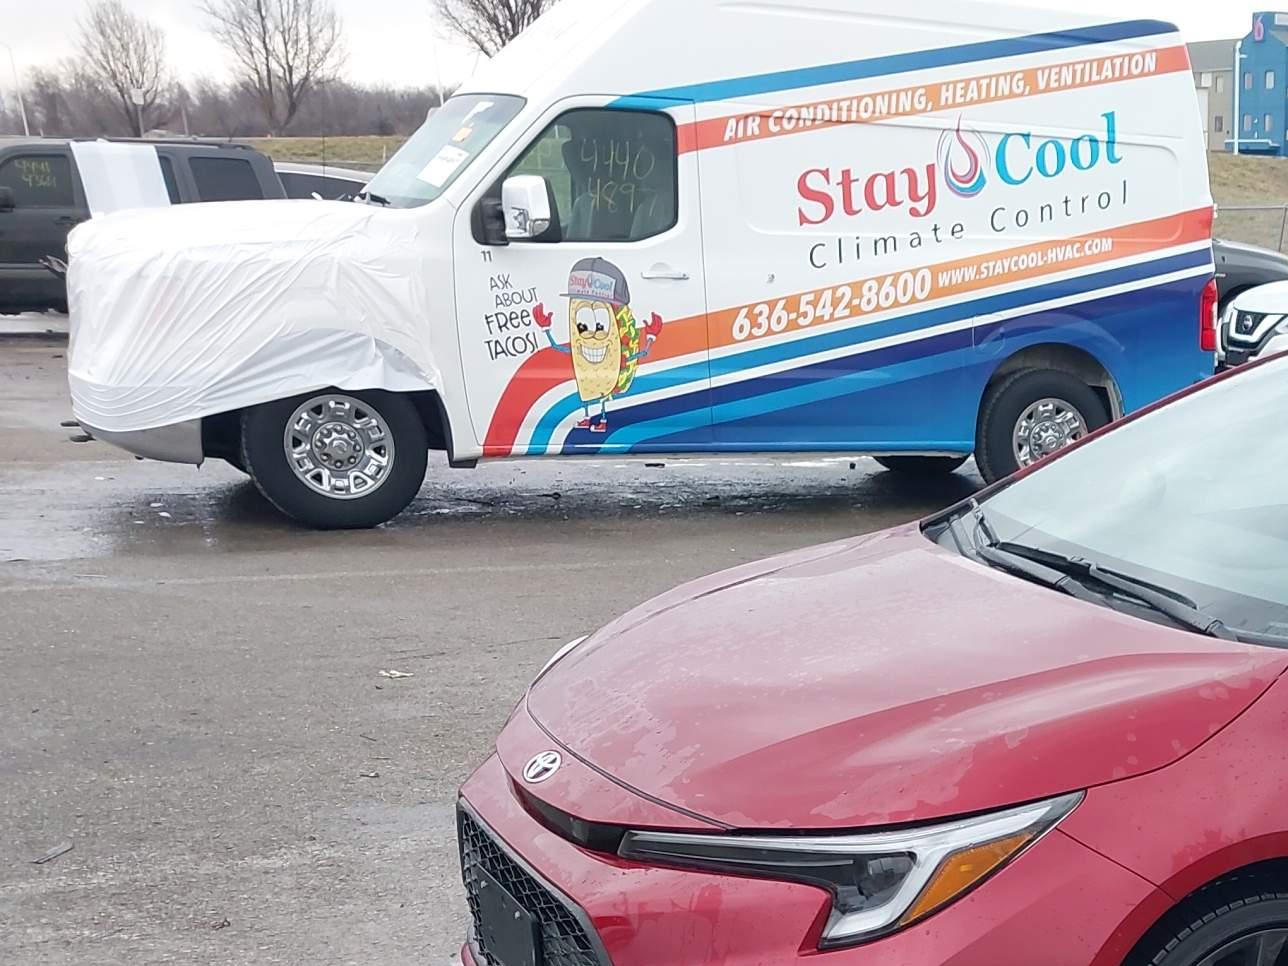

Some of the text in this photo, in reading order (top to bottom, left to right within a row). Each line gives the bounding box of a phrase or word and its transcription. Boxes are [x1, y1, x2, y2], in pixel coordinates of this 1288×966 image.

[1254, 14, 1264, 41] 6
[724, 52, 1157, 141] AIR CONDITIONING, HEATING, VENTILATION
[797, 111, 1123, 226] Stay Cool
[809, 179, 1127, 269] Climate Control
[481, 250, 492, 262] 11
[489, 273, 513, 291] ASK
[494, 287, 538, 309] ABOUT
[732, 238, 1113, 340] 636-542-8600 WWW.STAYCOOL-HVAC.COM
